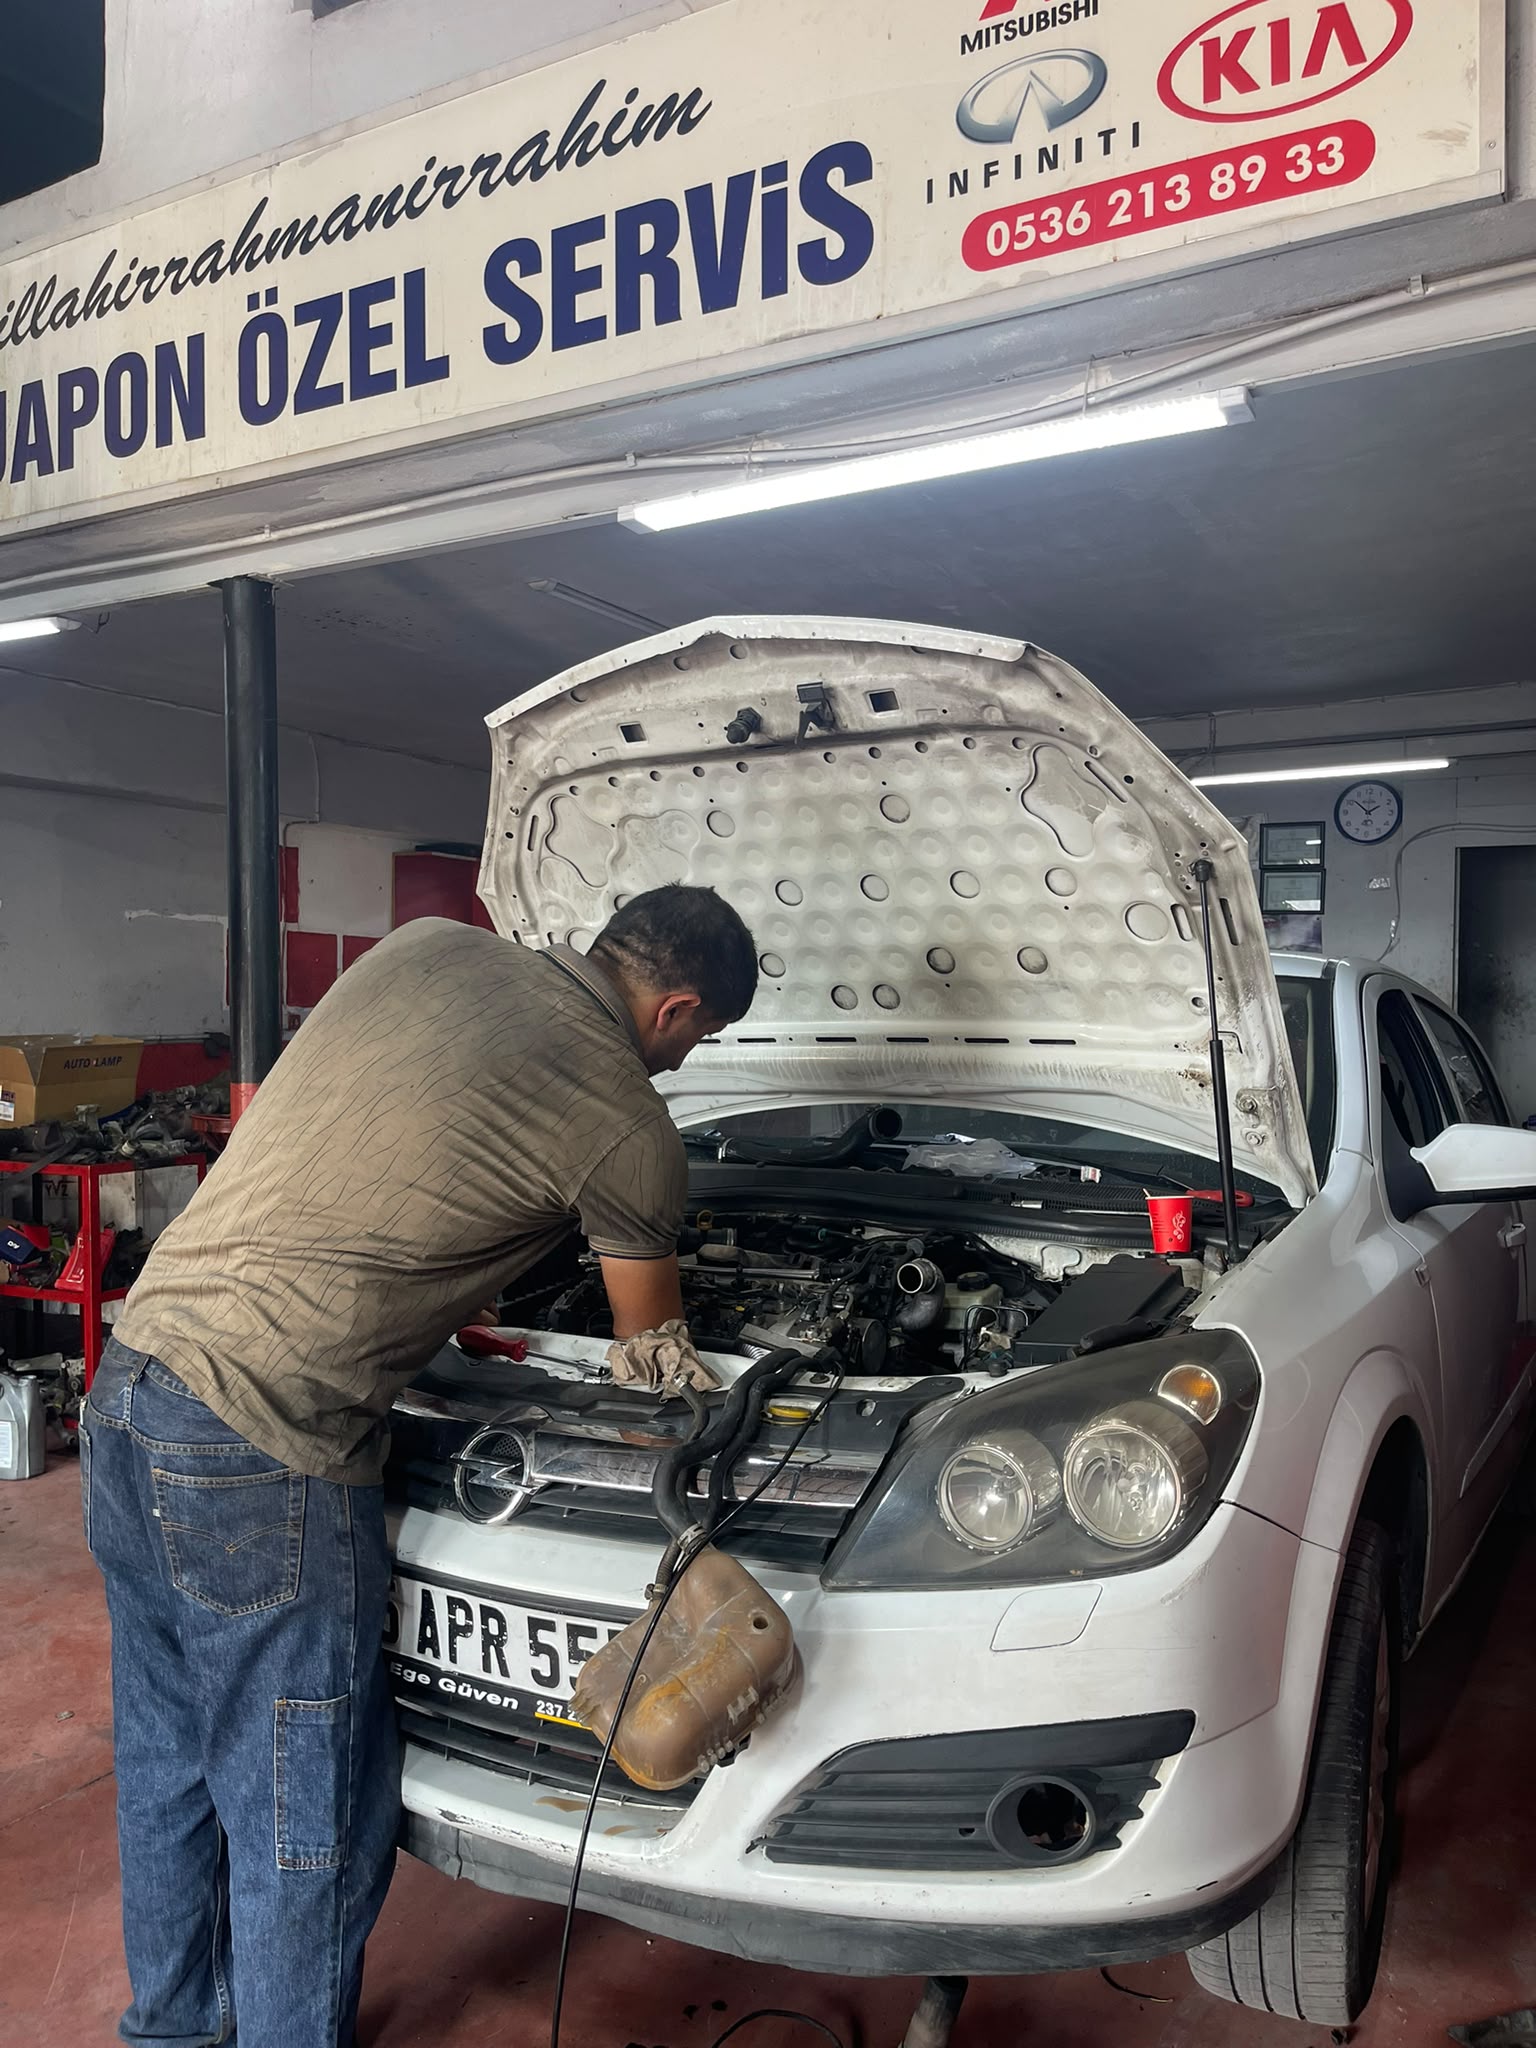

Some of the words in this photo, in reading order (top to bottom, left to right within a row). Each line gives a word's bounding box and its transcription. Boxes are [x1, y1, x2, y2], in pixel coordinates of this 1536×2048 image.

[960, 0, 1098, 55] MITSUBISHI
[1199, 2, 1368, 105] KIA
[926, 121, 1141, 204] INFINITI
[985, 199, 1092, 257] 0536
[1107, 173, 1191, 228] 213
[1209, 155, 1266, 201] 89
[1285, 136, 1345, 184] 33
[0, 332, 206, 484] APON
[238, 269, 450, 427] ÖZEL
[63, 1058, 91, 1070] AUTO
[94, 1056, 123, 1068] LAMP
[417, 1588, 511, 1678] APR
[527, 1615, 624, 1691] 55
[390, 1661, 431, 1684] Ege
[438, 1677, 519, 1710] Güven
[536, 1700, 563, 1716] 237
